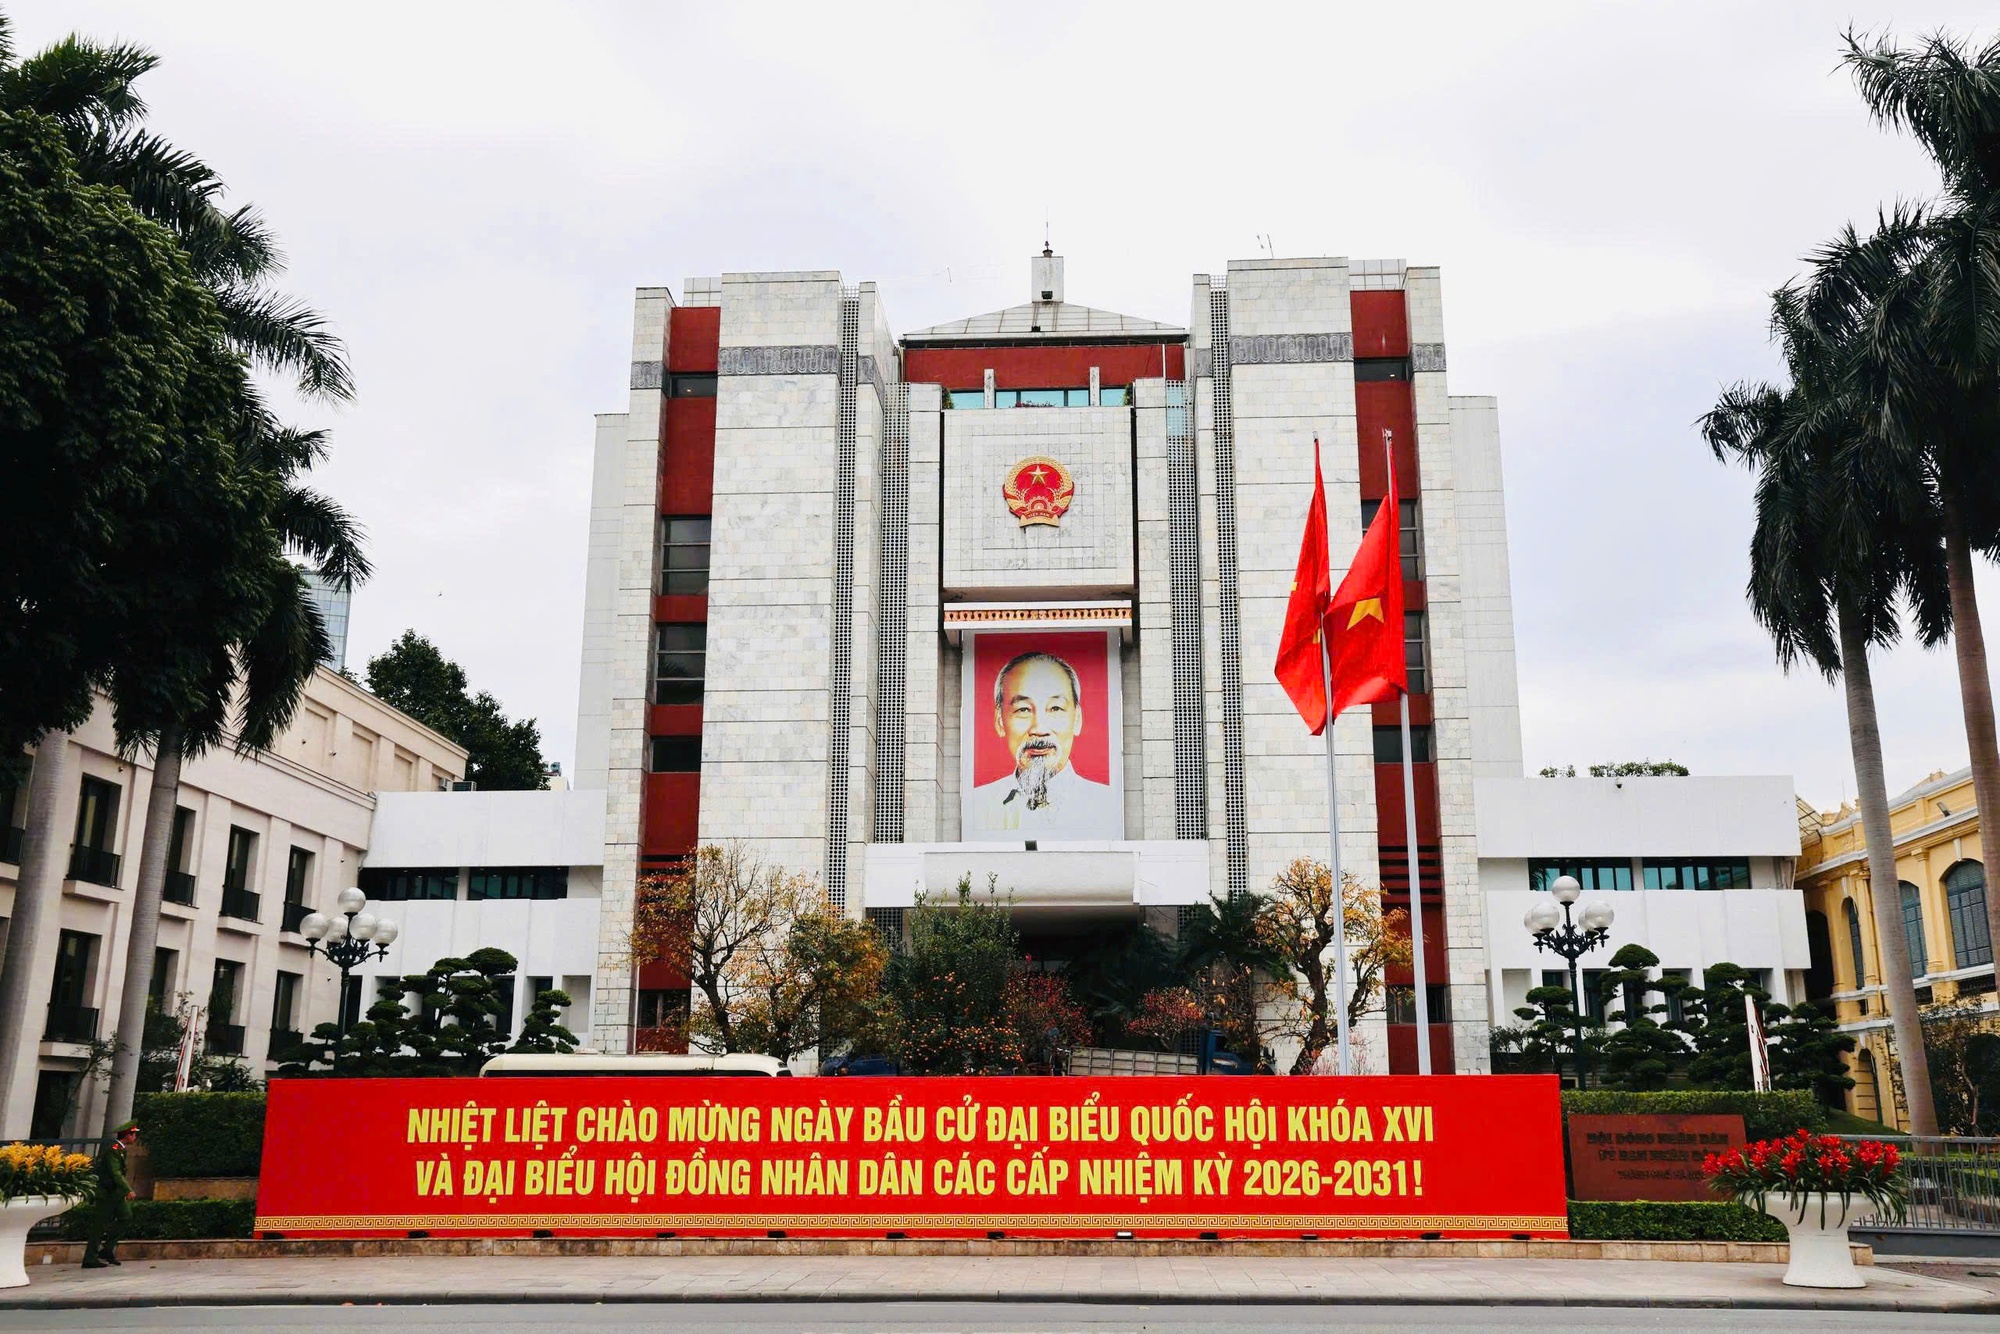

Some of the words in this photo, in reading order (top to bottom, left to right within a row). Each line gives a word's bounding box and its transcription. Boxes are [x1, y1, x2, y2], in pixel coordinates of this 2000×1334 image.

[408, 1101, 497, 1151] NHIỆT
[505, 1100, 568, 1150] LIỆT
[577, 1100, 658, 1142] CHÀO
[669, 1100, 761, 1142] MỪNG
[771, 1100, 854, 1142] NGÀY
[864, 1095, 925, 1142] BẦU
[936, 1095, 981, 1142] CỬ
[986, 1107, 1038, 1150] ĐẠI
[1050, 1092, 1120, 1142] BIỂU
[1131, 1094, 1214, 1146] QUỐC
[1225, 1099, 1277, 1150] HỘI
[1288, 1099, 1374, 1142] KHÓA
[1383, 1107, 1434, 1142] XVI
[416, 1153, 454, 1196] VÀ
[463, 1160, 516, 1204] ĐẠI
[525, 1146, 596, 1196] BIỂU
[605, 1152, 656, 1204] HỘI
[665, 1148, 751, 1196] ĐỒNG
[762, 1152, 849, 1196] NHÂN
[859, 1152, 923, 1196] DÂN
[934, 1152, 996, 1196] CÁC
[1006, 1147, 1069, 1196] CẤP
[1080, 1152, 1183, 1204] NHIỆM
[1194, 1152, 1234, 1196] KỲ
[1244, 1159, 1423, 1197] 2026-2031!
